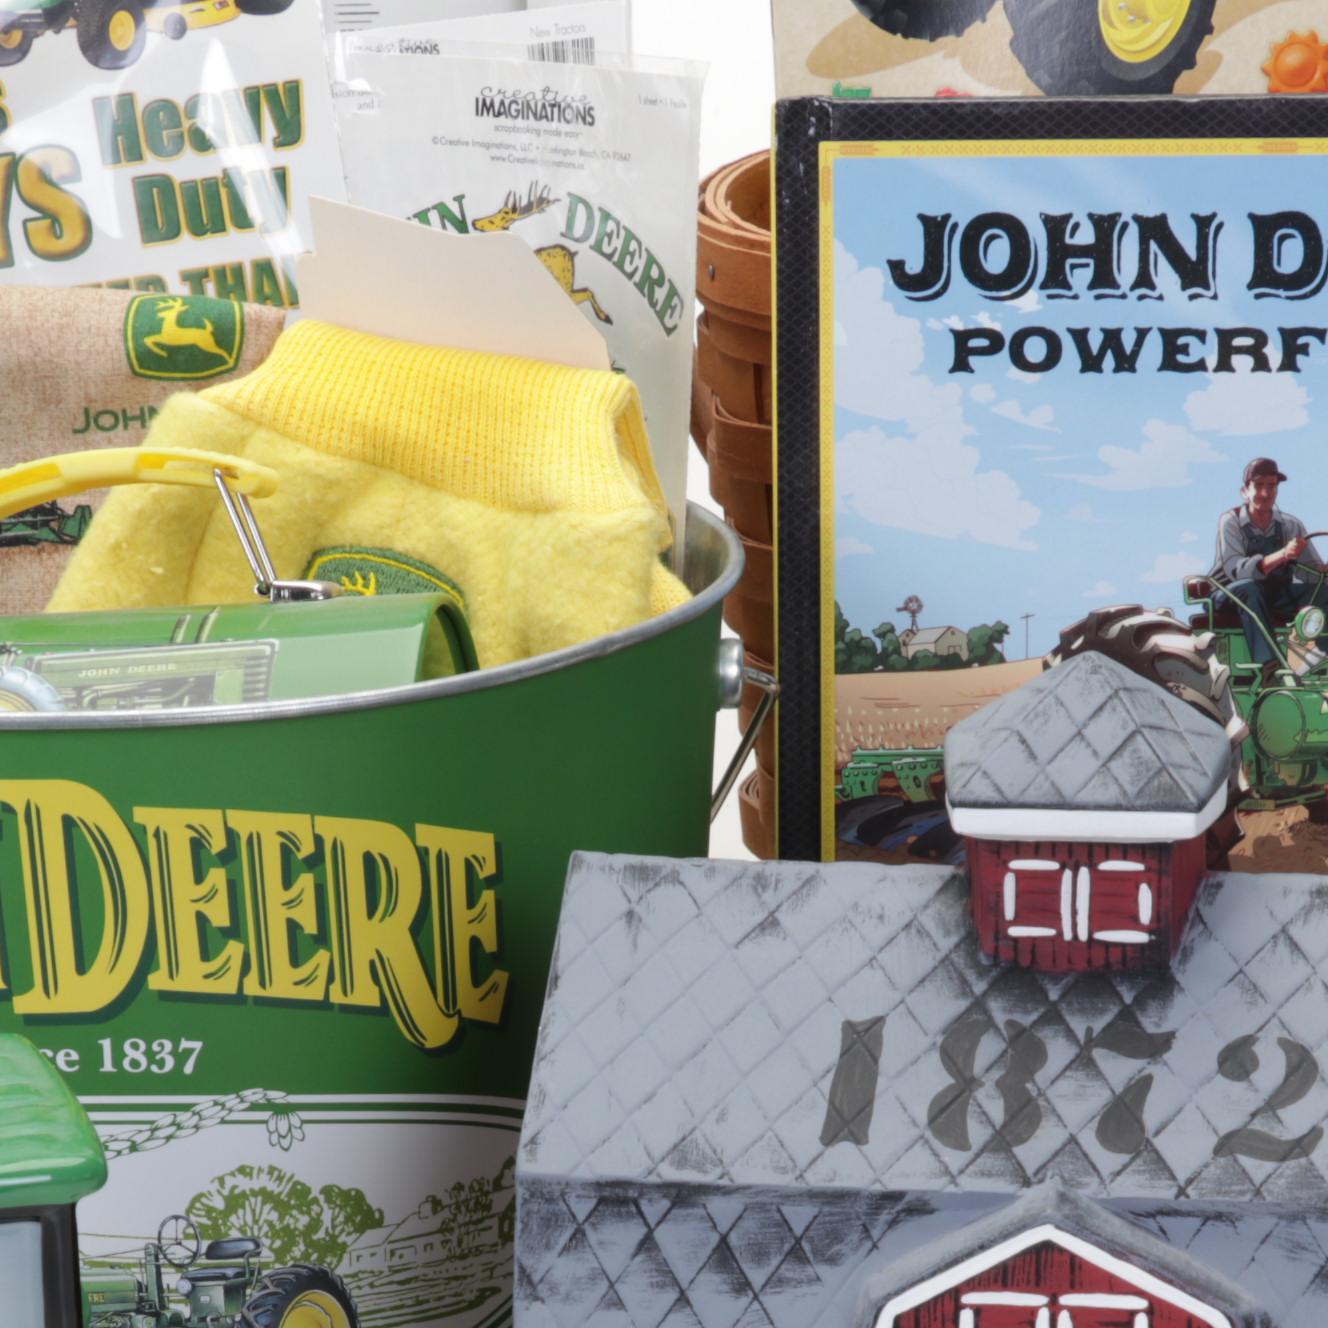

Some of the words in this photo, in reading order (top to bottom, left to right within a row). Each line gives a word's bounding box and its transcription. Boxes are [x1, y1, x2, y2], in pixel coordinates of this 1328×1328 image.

[475, 97, 596, 127] IMAGINATIONS
[521, 142, 533, 152] LLC
[541, 145, 578, 157] tington
[560, 192, 684, 337] DEERE
[886, 210, 1223, 303] JOHN
[78, 667, 121, 678] JOHN
[128, 663, 177, 674] DEERE
[97, 1037, 204, 1075] 1837
[819, 1015, 1324, 1161] 1872
